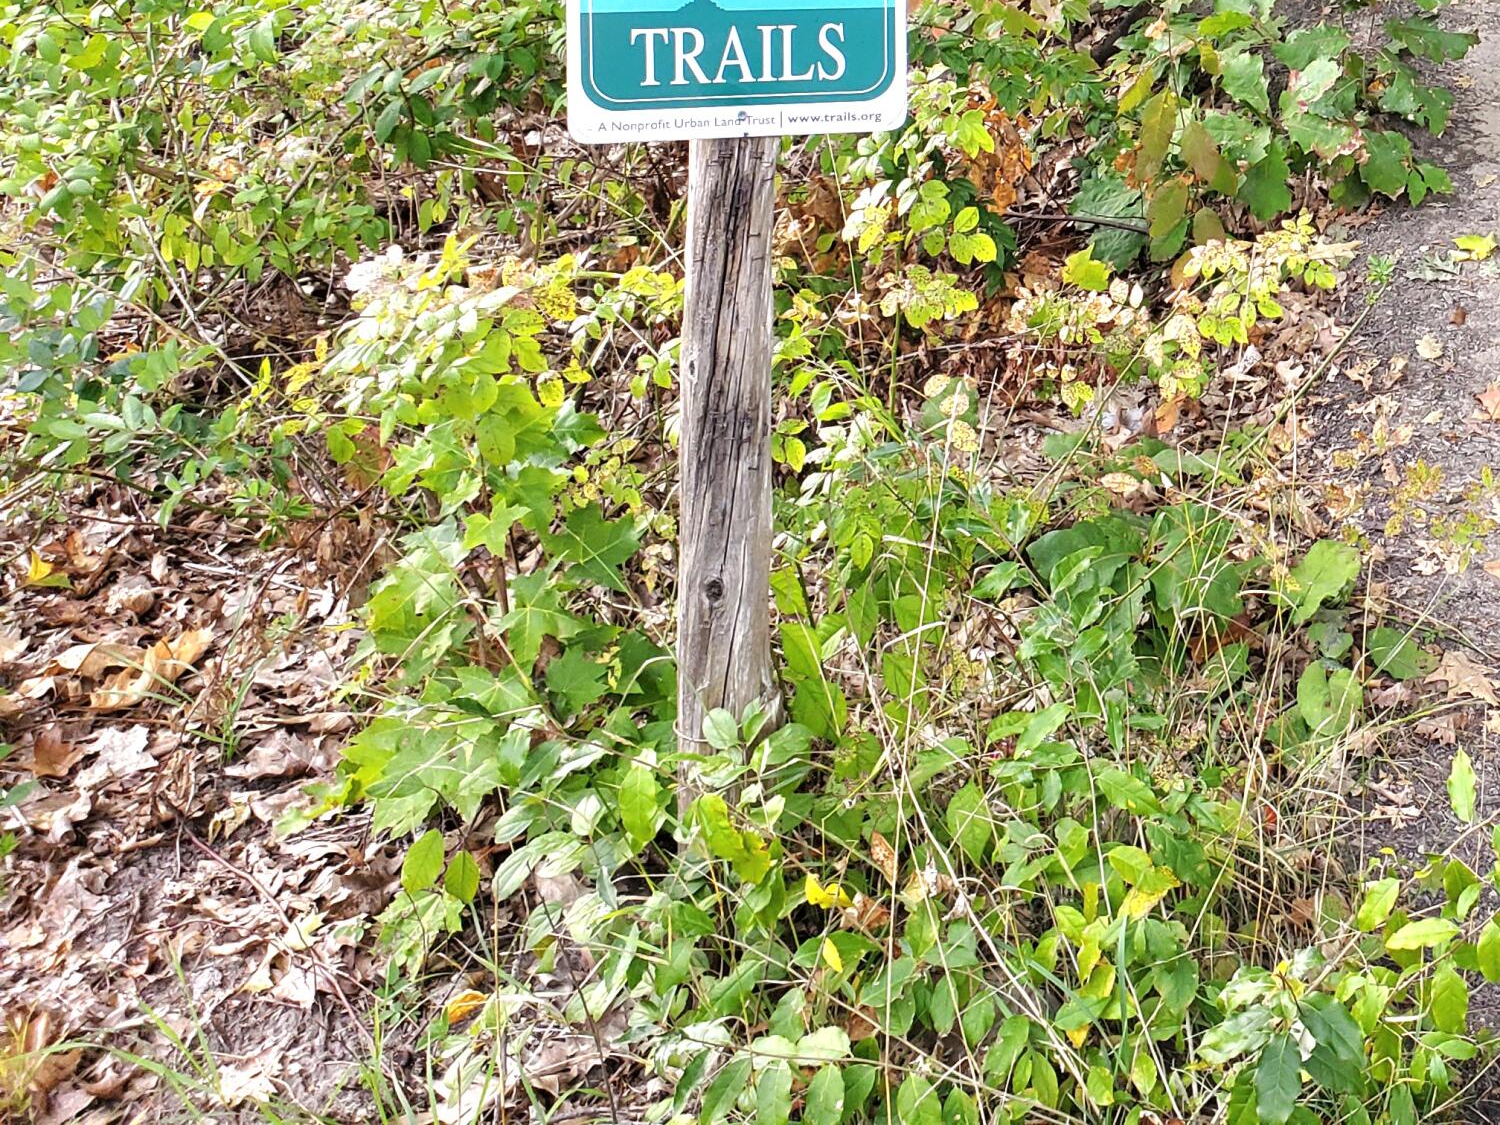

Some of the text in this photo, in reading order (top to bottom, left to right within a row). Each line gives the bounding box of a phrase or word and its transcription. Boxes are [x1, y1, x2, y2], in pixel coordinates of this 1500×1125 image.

[631, 23, 845, 85] TRAILS
[598, 121, 607, 132] A
[611, 119, 671, 133] Nonprofit
[674, 117, 710, 129] Urban
[746, 115, 776, 126] Trust
[788, 111, 883, 124] www.trails.org
